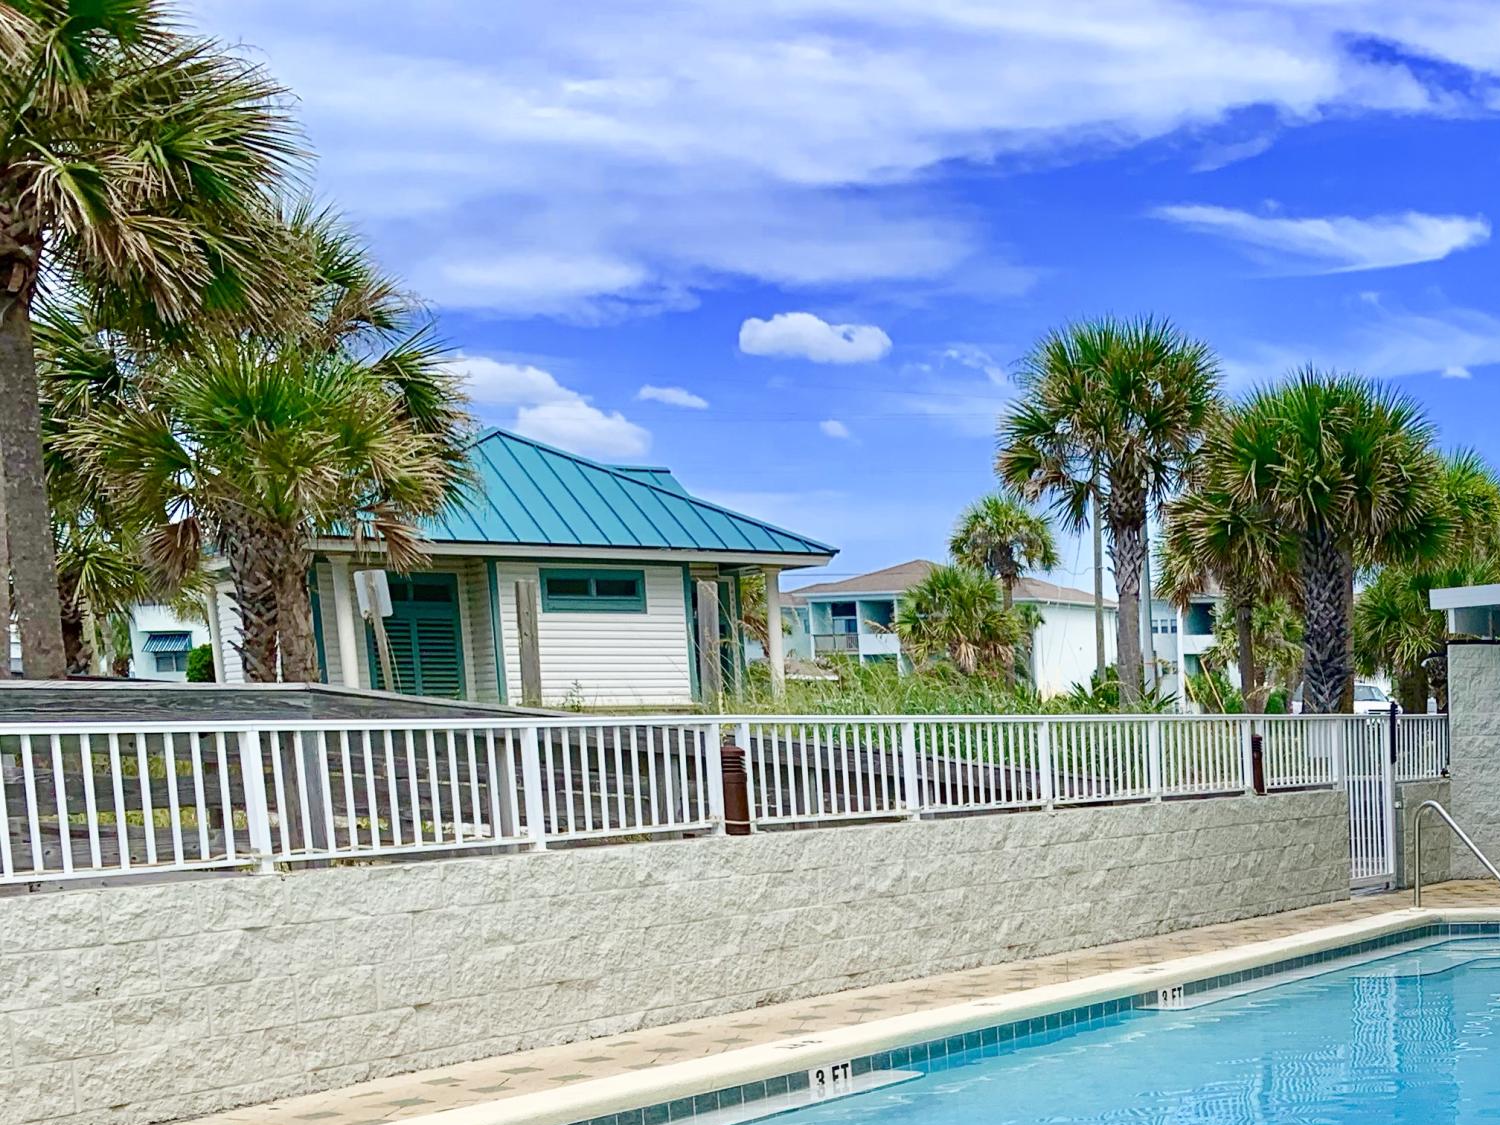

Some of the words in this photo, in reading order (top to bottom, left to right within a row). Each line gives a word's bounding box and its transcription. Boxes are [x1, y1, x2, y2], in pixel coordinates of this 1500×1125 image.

[1171, 986, 1182, 1000] FT
[815, 1069, 825, 1085] 3
[831, 1063, 849, 1082] FT
